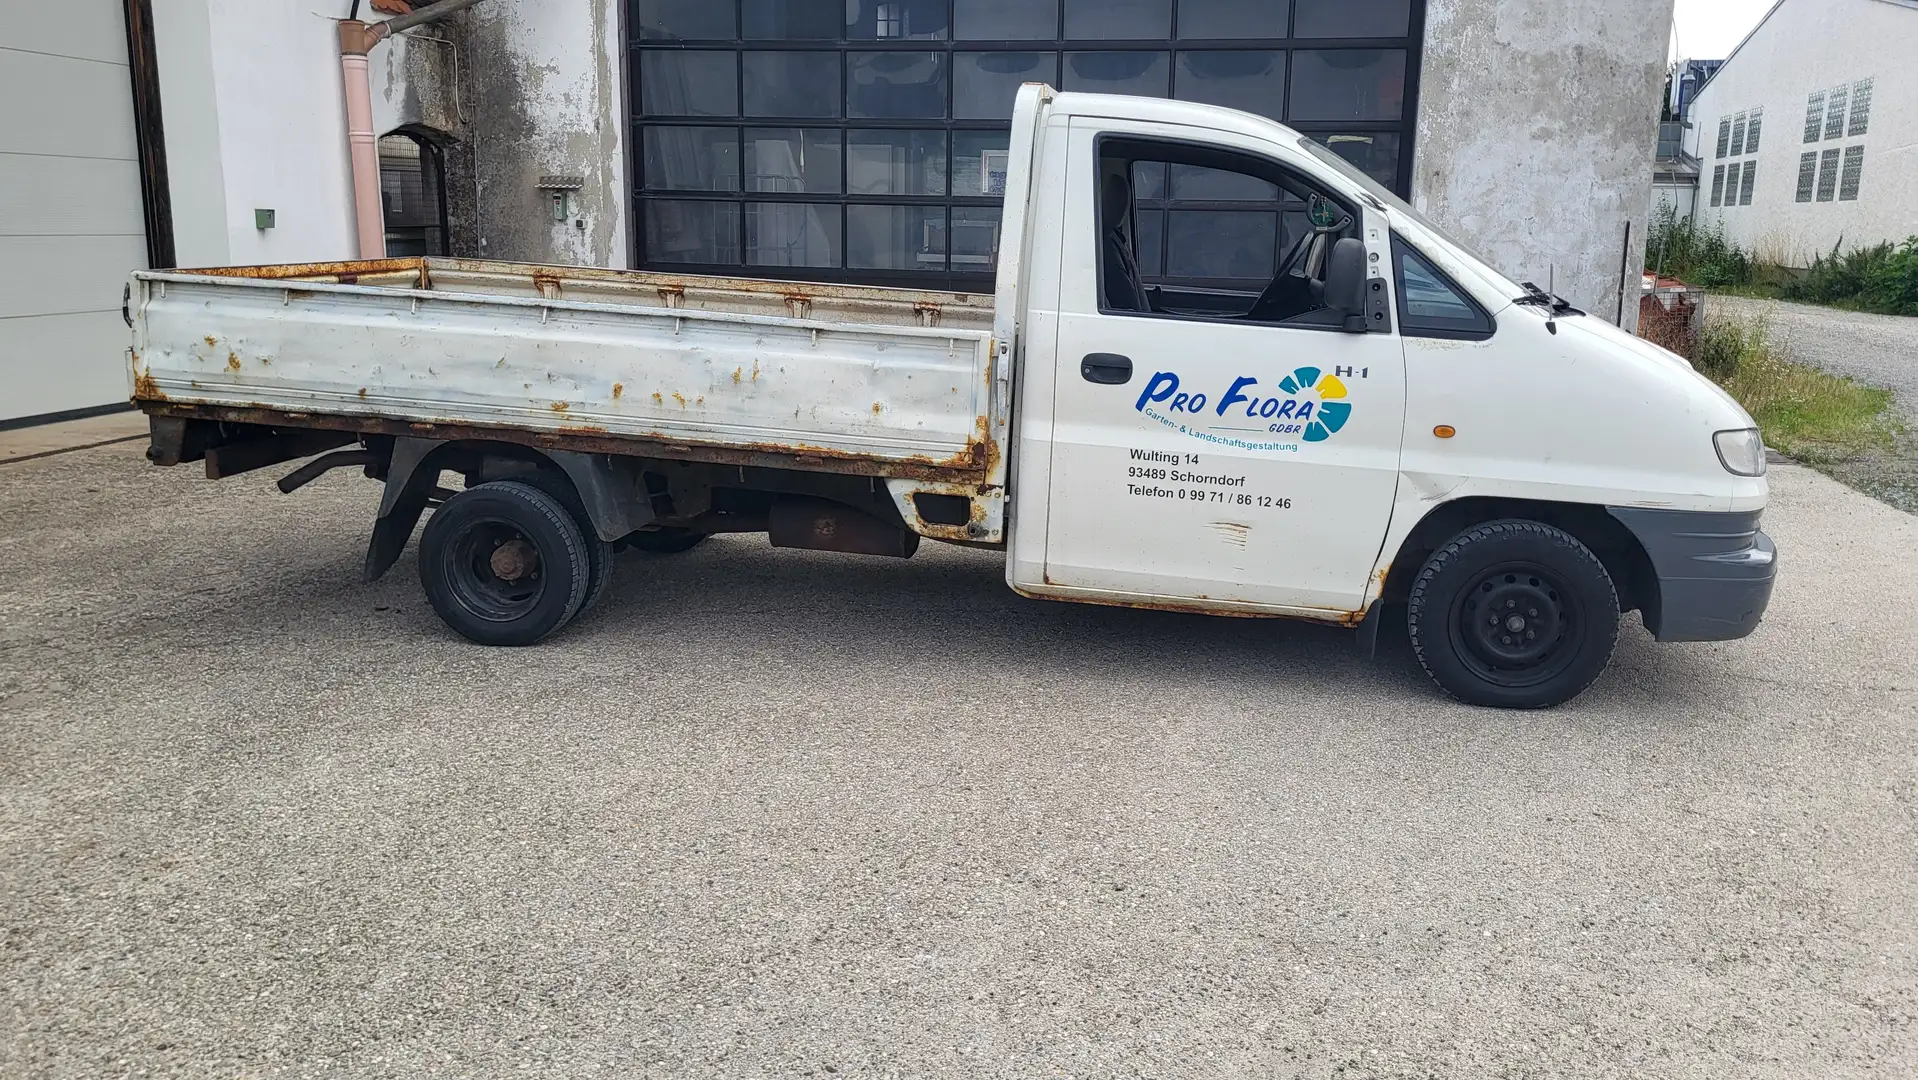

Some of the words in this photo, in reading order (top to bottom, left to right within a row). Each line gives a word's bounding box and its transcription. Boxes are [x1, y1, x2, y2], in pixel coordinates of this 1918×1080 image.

[1336, 365, 1368, 378] H-1
[1145, 407, 1178, 428] Garten-
[1179, 424, 1187, 433] &
[1189, 428, 1298, 451] Landschaftsgestaltung
[1269, 424, 1301, 434] GDBR
[1130, 449, 1179, 465] Wulting
[1184, 454, 1199, 465] 14
[1128, 467, 1166, 480] 93489
[1170, 470, 1245, 487] Schorndorf
[1127, 485, 1174, 499] Telefon
[1178, 489, 1186, 499] 0
[1190, 490, 1204, 501] 99
[1210, 491, 1224, 503] 71
[1228, 494, 1234, 504] /
[1237, 494, 1252, 505] 86
[1257, 496, 1271, 507] 12
[1276, 498, 1291, 509] 46
